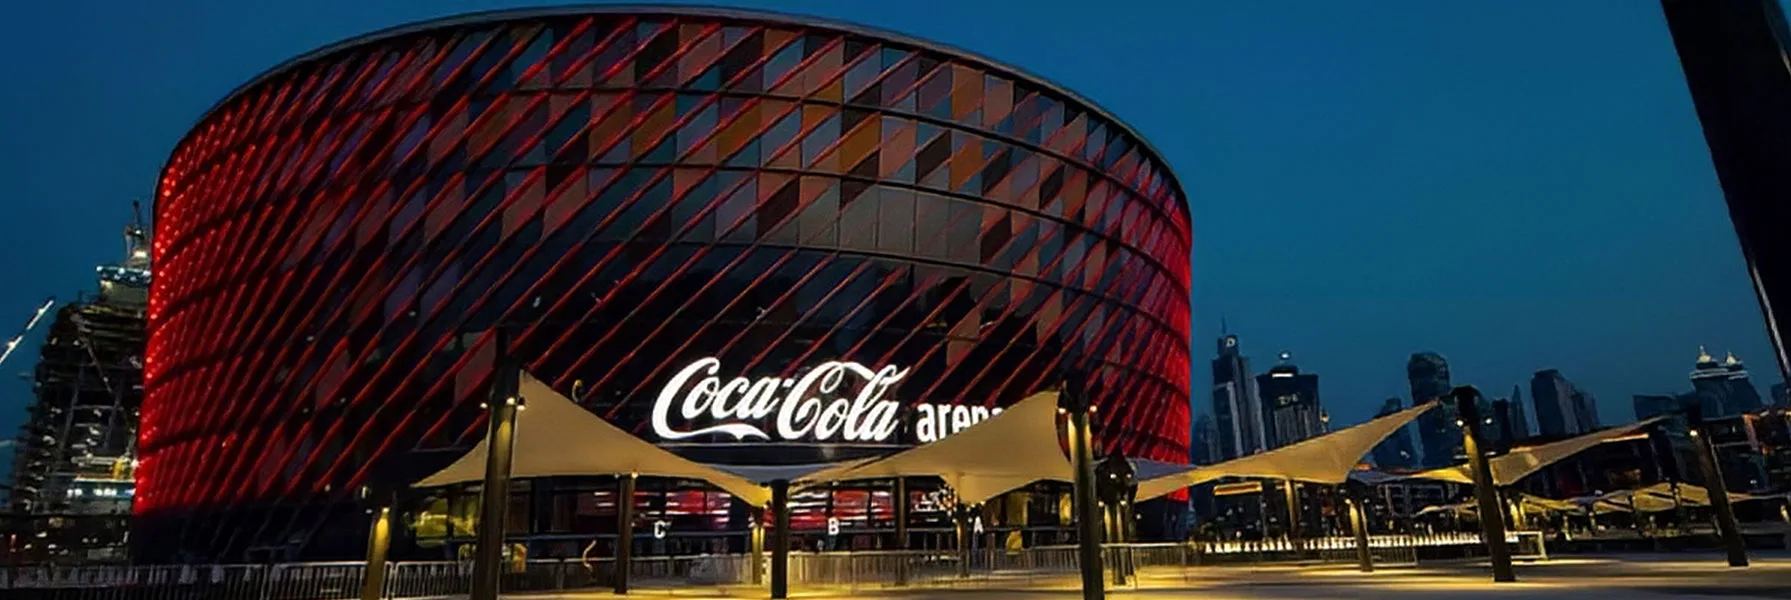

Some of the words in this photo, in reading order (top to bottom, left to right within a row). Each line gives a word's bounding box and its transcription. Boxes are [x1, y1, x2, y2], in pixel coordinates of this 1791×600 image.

[652, 357, 910, 441] Coca-Cola
[916, 403, 1004, 442] aren
[654, 520, 666, 538] C
[828, 517, 839, 535] B
[974, 516, 983, 534] A
